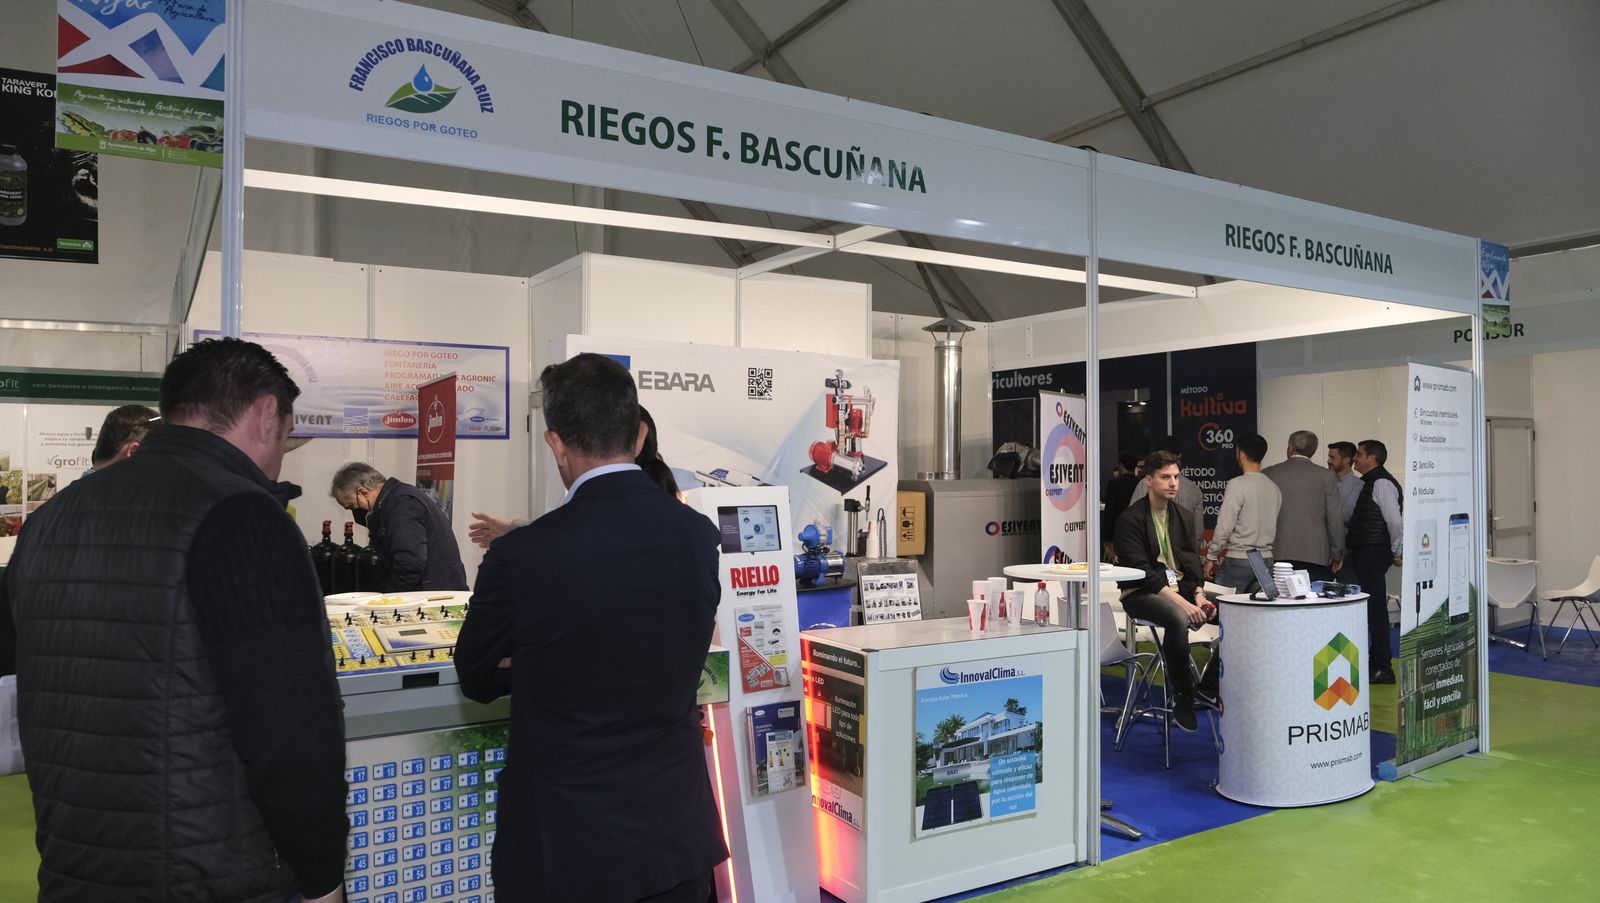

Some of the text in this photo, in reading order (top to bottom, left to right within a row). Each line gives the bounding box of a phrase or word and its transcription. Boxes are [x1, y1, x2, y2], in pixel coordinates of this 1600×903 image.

[348, 37, 494, 114] FRANCISCO BASCUÑANA RUIZ
[1, 77, 48, 89] TARAVERT
[1, 83, 32, 95] KING
[366, 113, 478, 139] RIEGOS POR GOTEO
[560, 99, 927, 194] RIEGOS F. BASCUÑANA
[1225, 223, 1393, 275] RIEGOS F. BASCUÑANA
[383, 349, 458, 360] RIEGO POR GOTEO
[460, 374, 497, 383] AGRONIC
[638, 370, 715, 393] EBARA
[384, 383, 403, 391] AIRE
[1180, 386, 1208, 395] MÉTODO
[1063, 410, 1086, 445] ESIVENT
[1206, 429, 1234, 444] 360
[1418, 461, 1435, 470] Sencillo
[1049, 463, 1084, 484] ESIVENT
[1069, 521, 1086, 532] ESIVENT
[730, 564, 780, 590] RIELLO
[812, 648, 838, 663] Iluminando
[1420, 641, 1465, 660] Sensores Agrícolas
[1425, 659, 1461, 676] conectados de
[960, 667, 1016, 684] InnovalClima
[815, 677, 825, 685] LED
[1420, 674, 1465, 694] forma inmediata,
[1423, 689, 1462, 711] fácil y sencilla
[832, 706, 841, 715] LED
[841, 709, 851, 718] para
[838, 720, 852, 730] tipo de
[1288, 711, 1369, 746] PRISMAB
[470, 754, 478, 764] 21
[496, 750, 504, 760] 22
[998, 755, 1026, 765] Un sistema
[443, 758, 451, 768] 20
[1310, 751, 1363, 770] www.prismab.com
[387, 767, 395, 777] 18
[415, 763, 424, 773] 19
[991, 768, 1013, 776] cómodo
[357, 771, 366, 781] 17
[470, 775, 478, 785] 28
[990, 778, 1003, 786] para
[1003, 774, 1026, 784] disponer
[415, 784, 424, 794] 26
[443, 780, 451, 789] 27
[993, 783, 1031, 795] agua calentada
[357, 793, 366, 803] 24
[386, 788, 395, 798] 25
[470, 796, 478, 805] 35
[991, 798, 999, 806] por
[1006, 794, 1024, 802] acción
[415, 805, 424, 815] 33
[443, 801, 452, 811] 34
[357, 814, 366, 825] 31
[387, 810, 396, 820] 32
[443, 821, 452, 831] 41
[470, 817, 478, 826] 42
[415, 826, 424, 836] 40
[358, 836, 366, 847] 38
[387, 832, 396, 841] 39
[444, 843, 452, 852] 48
[470, 838, 479, 847] 49
[415, 848, 424, 857] 47
[387, 853, 396, 863] 46
[470, 858, 479, 868] 56
[358, 858, 367, 869] 45
[444, 864, 452, 873] 55
[416, 869, 425, 878] 54
[358, 880, 367, 890] 52
[387, 875, 396, 885] 53
[471, 879, 479, 888] 63
[444, 885, 452, 894] 62
[416, 891, 424, 900] 61
